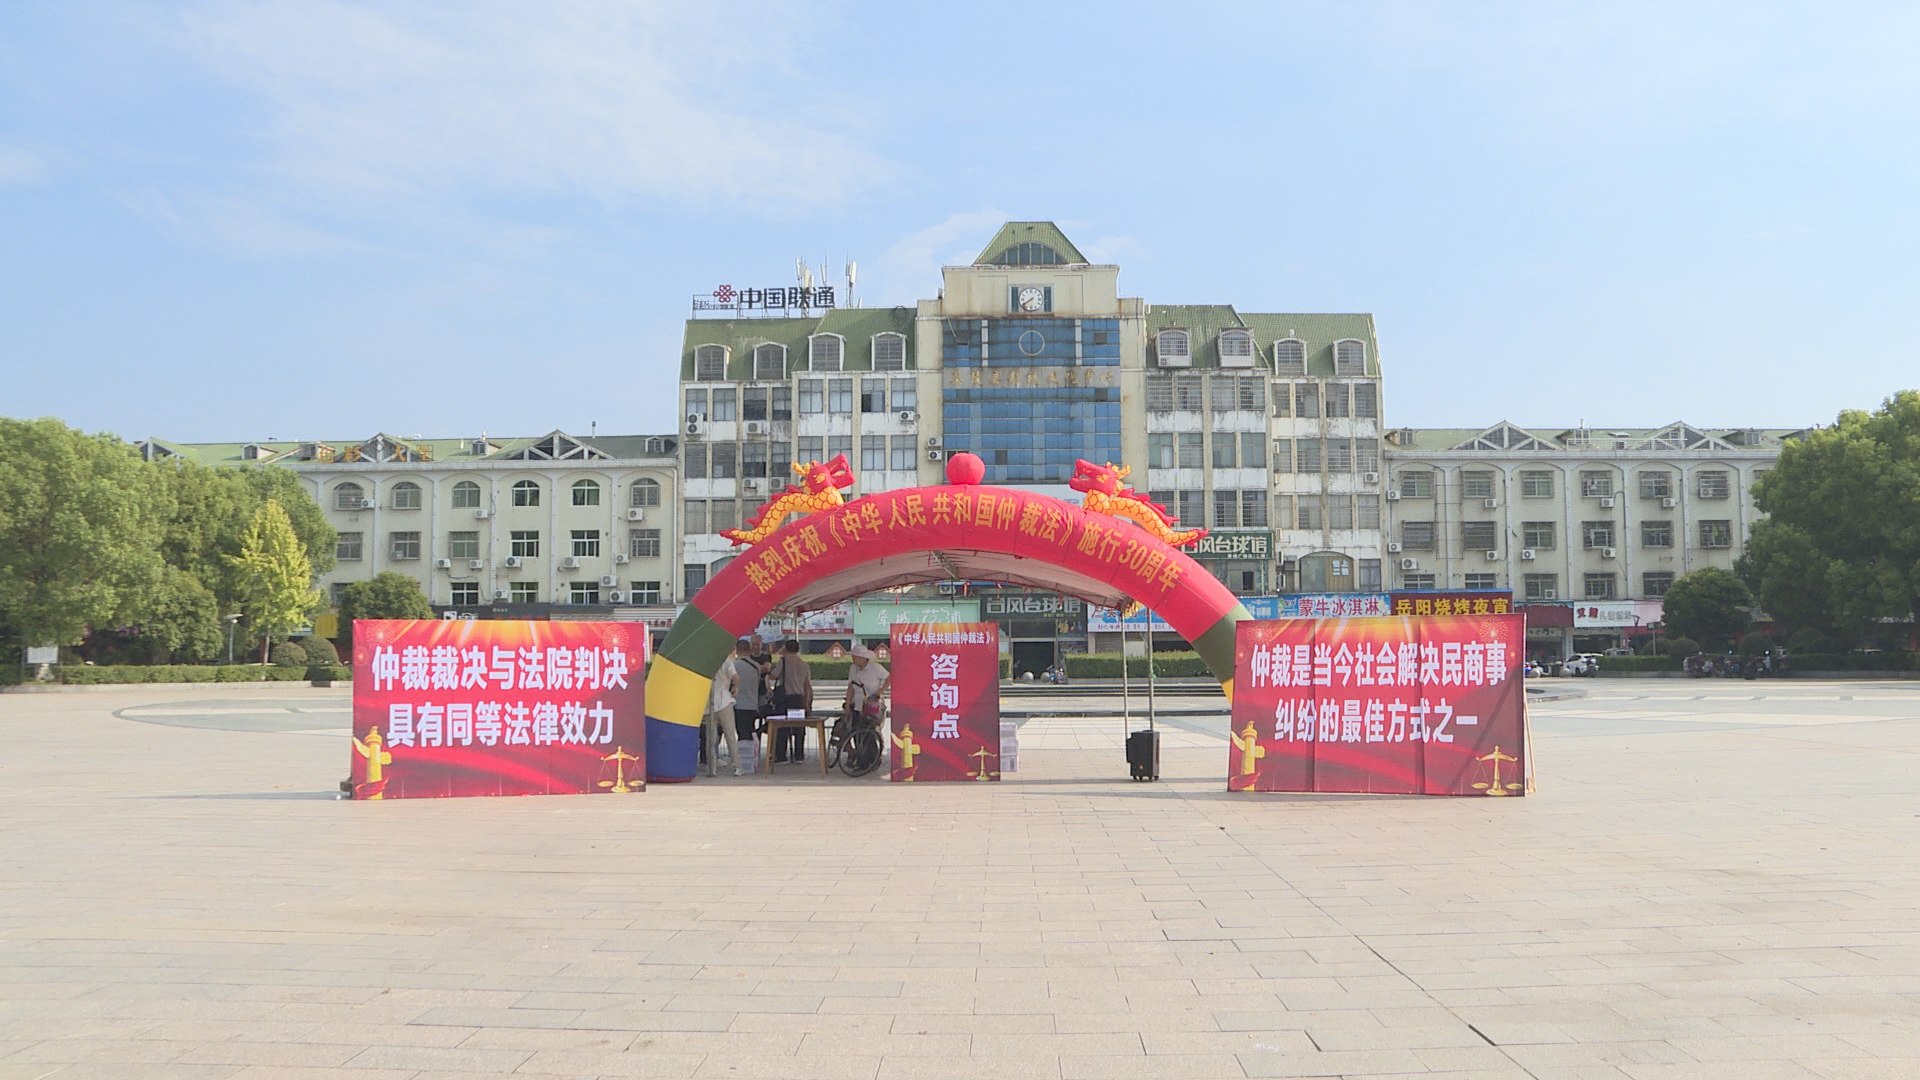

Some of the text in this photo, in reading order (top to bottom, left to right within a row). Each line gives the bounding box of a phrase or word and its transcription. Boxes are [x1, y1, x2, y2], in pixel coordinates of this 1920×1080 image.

[740, 286, 835, 309] 中国联通
[744, 491, 1183, 594] 热烈庆祝《中华人民共和国仲裁法》施行30周年
[1298, 597, 1380, 617] 蒙牛冰淇淋
[1395, 597, 1509, 617] 岳阳烧烤夜宵
[898, 631, 991, 646] 《中华人民共和国仲裁法》
[371, 645, 629, 691] 仲裁裁决与法院判决
[1250, 640, 1508, 689] 仲裁是当今社会解决民商事
[930, 653, 960, 740] 咨询点
[386, 700, 615, 748] 具有同等法律效力
[1273, 697, 1479, 744] 纠纷的最佳方式之一
